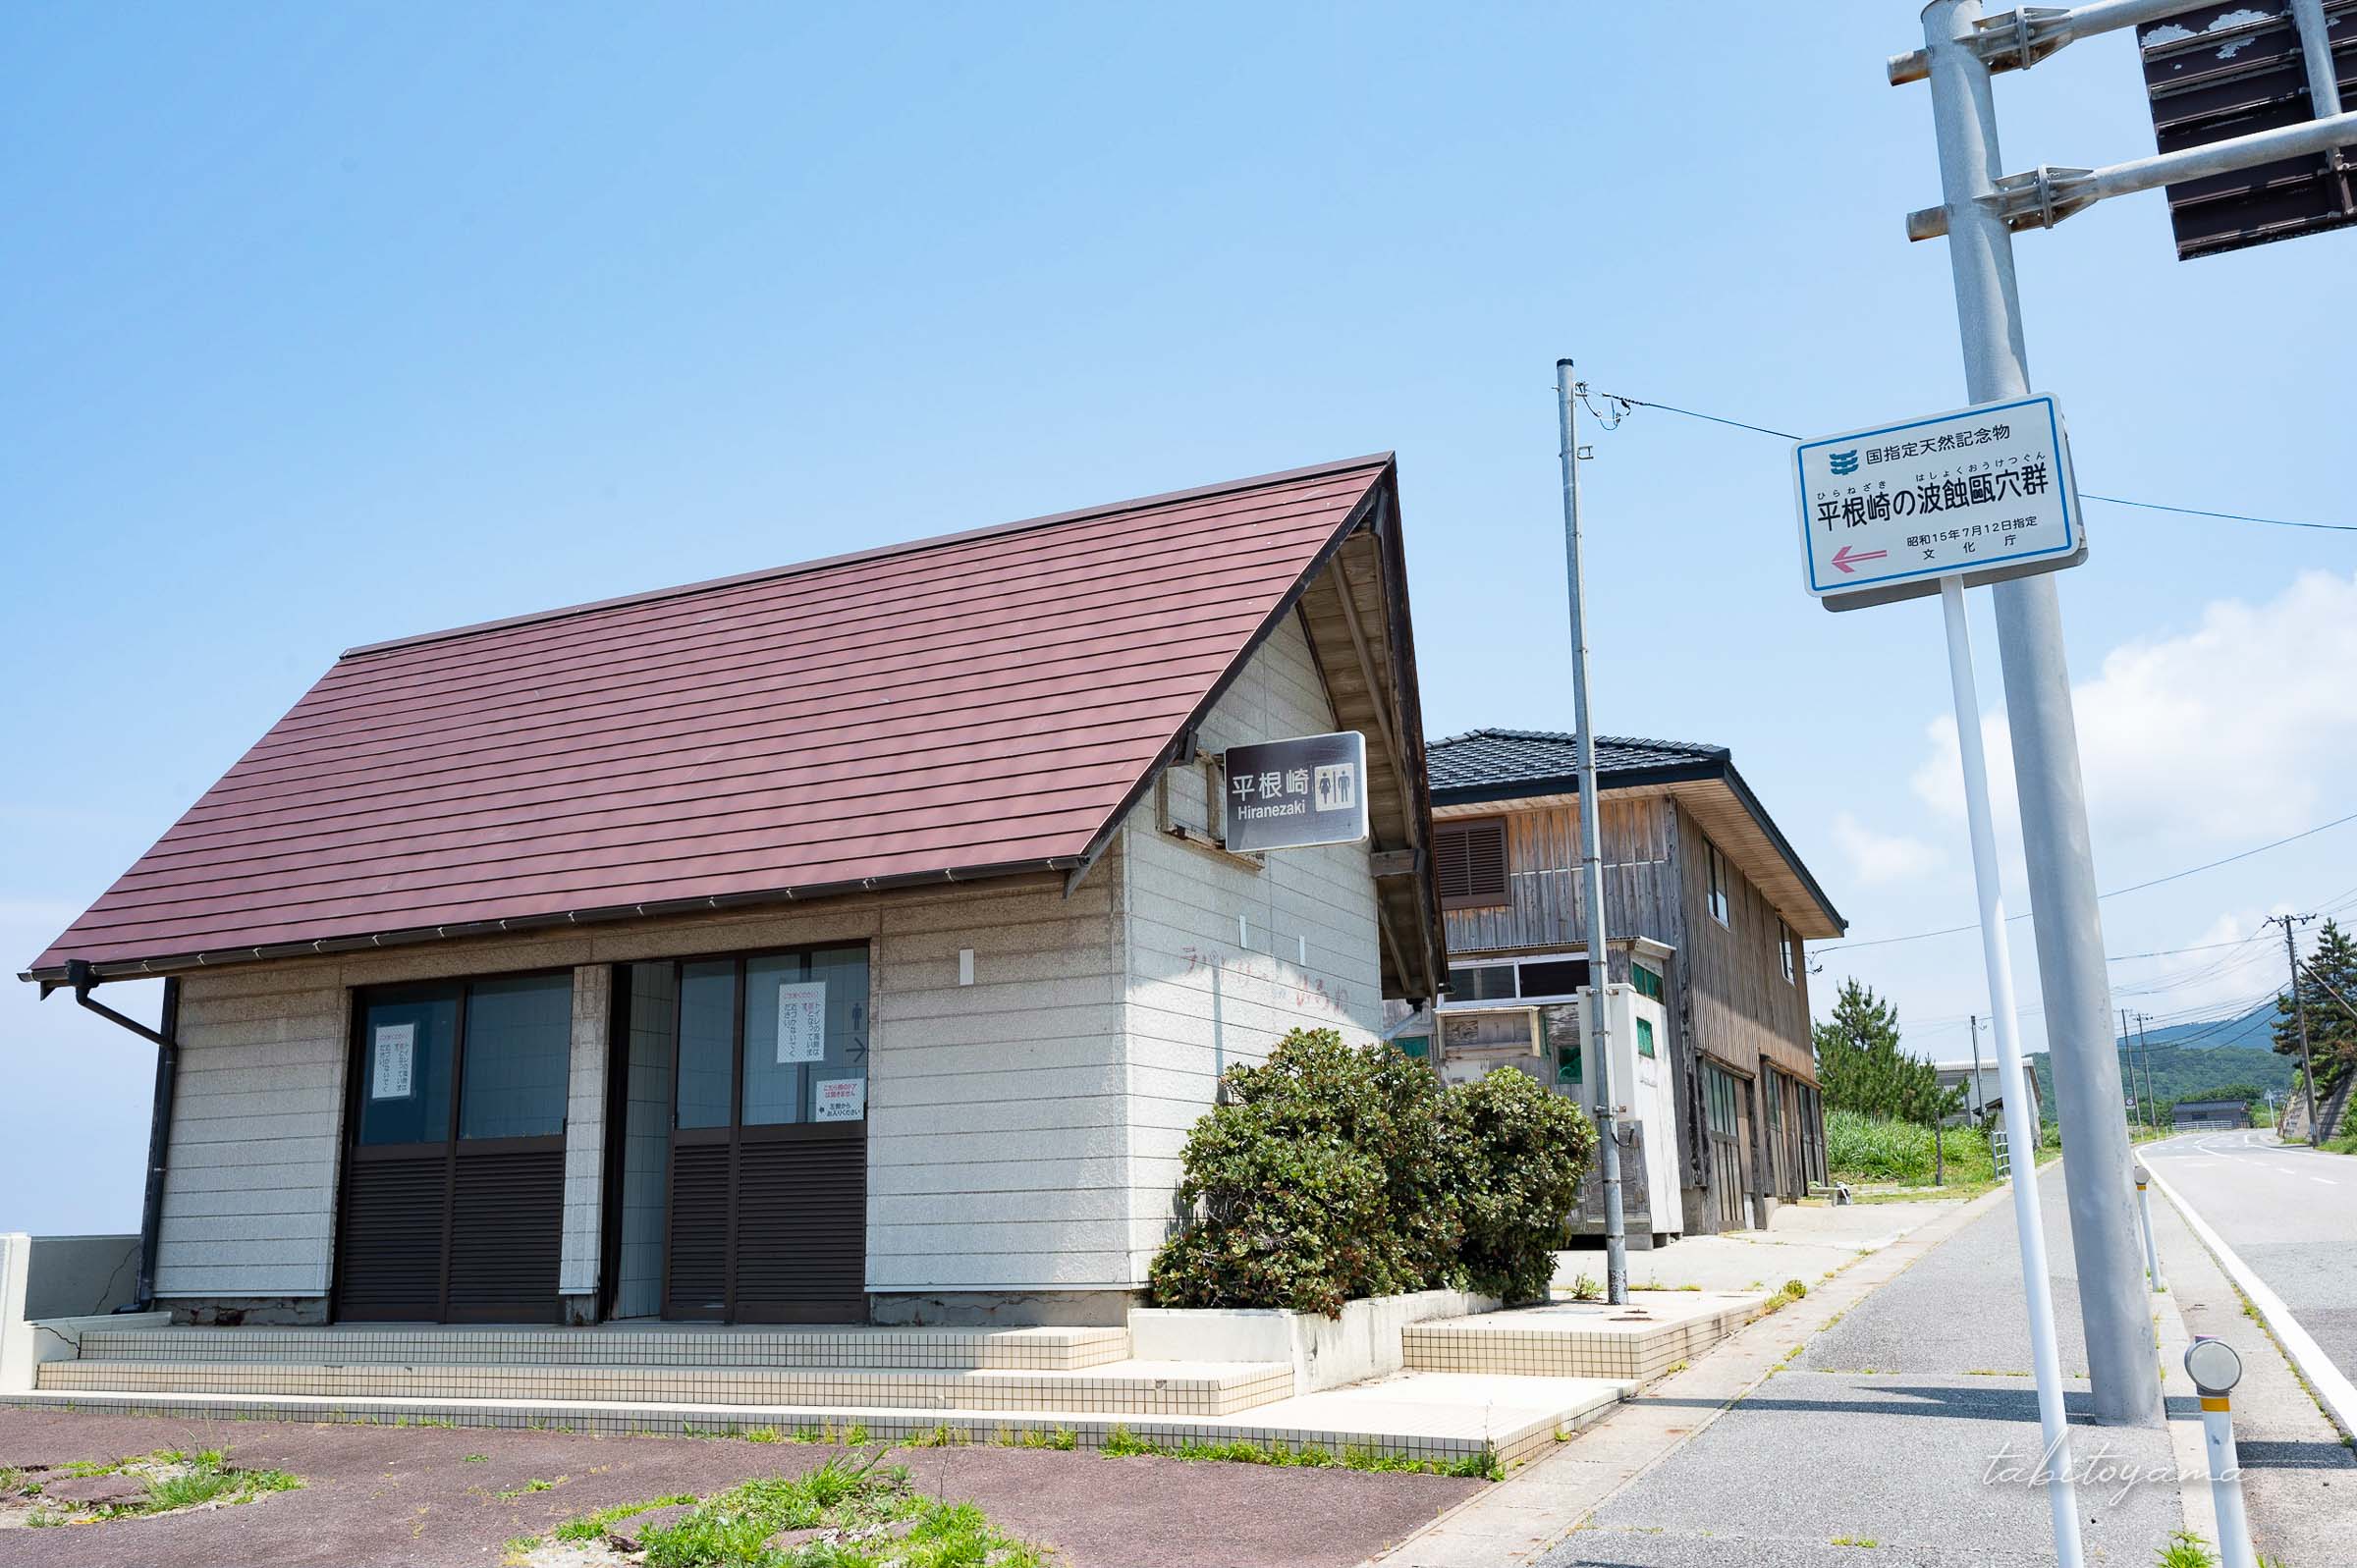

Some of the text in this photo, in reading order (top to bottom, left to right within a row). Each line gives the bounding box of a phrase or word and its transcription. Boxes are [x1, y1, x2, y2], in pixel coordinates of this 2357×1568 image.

[1866, 424, 2010, 464] 国指定天然記念物
[1916, 452, 2046, 482] はしょくおうけつぐん
[1817, 480, 1887, 500] ひらねざき
[1232, 768, 1310, 802] 平根崎
[1237, 799, 1306, 821] Hiranezaki
